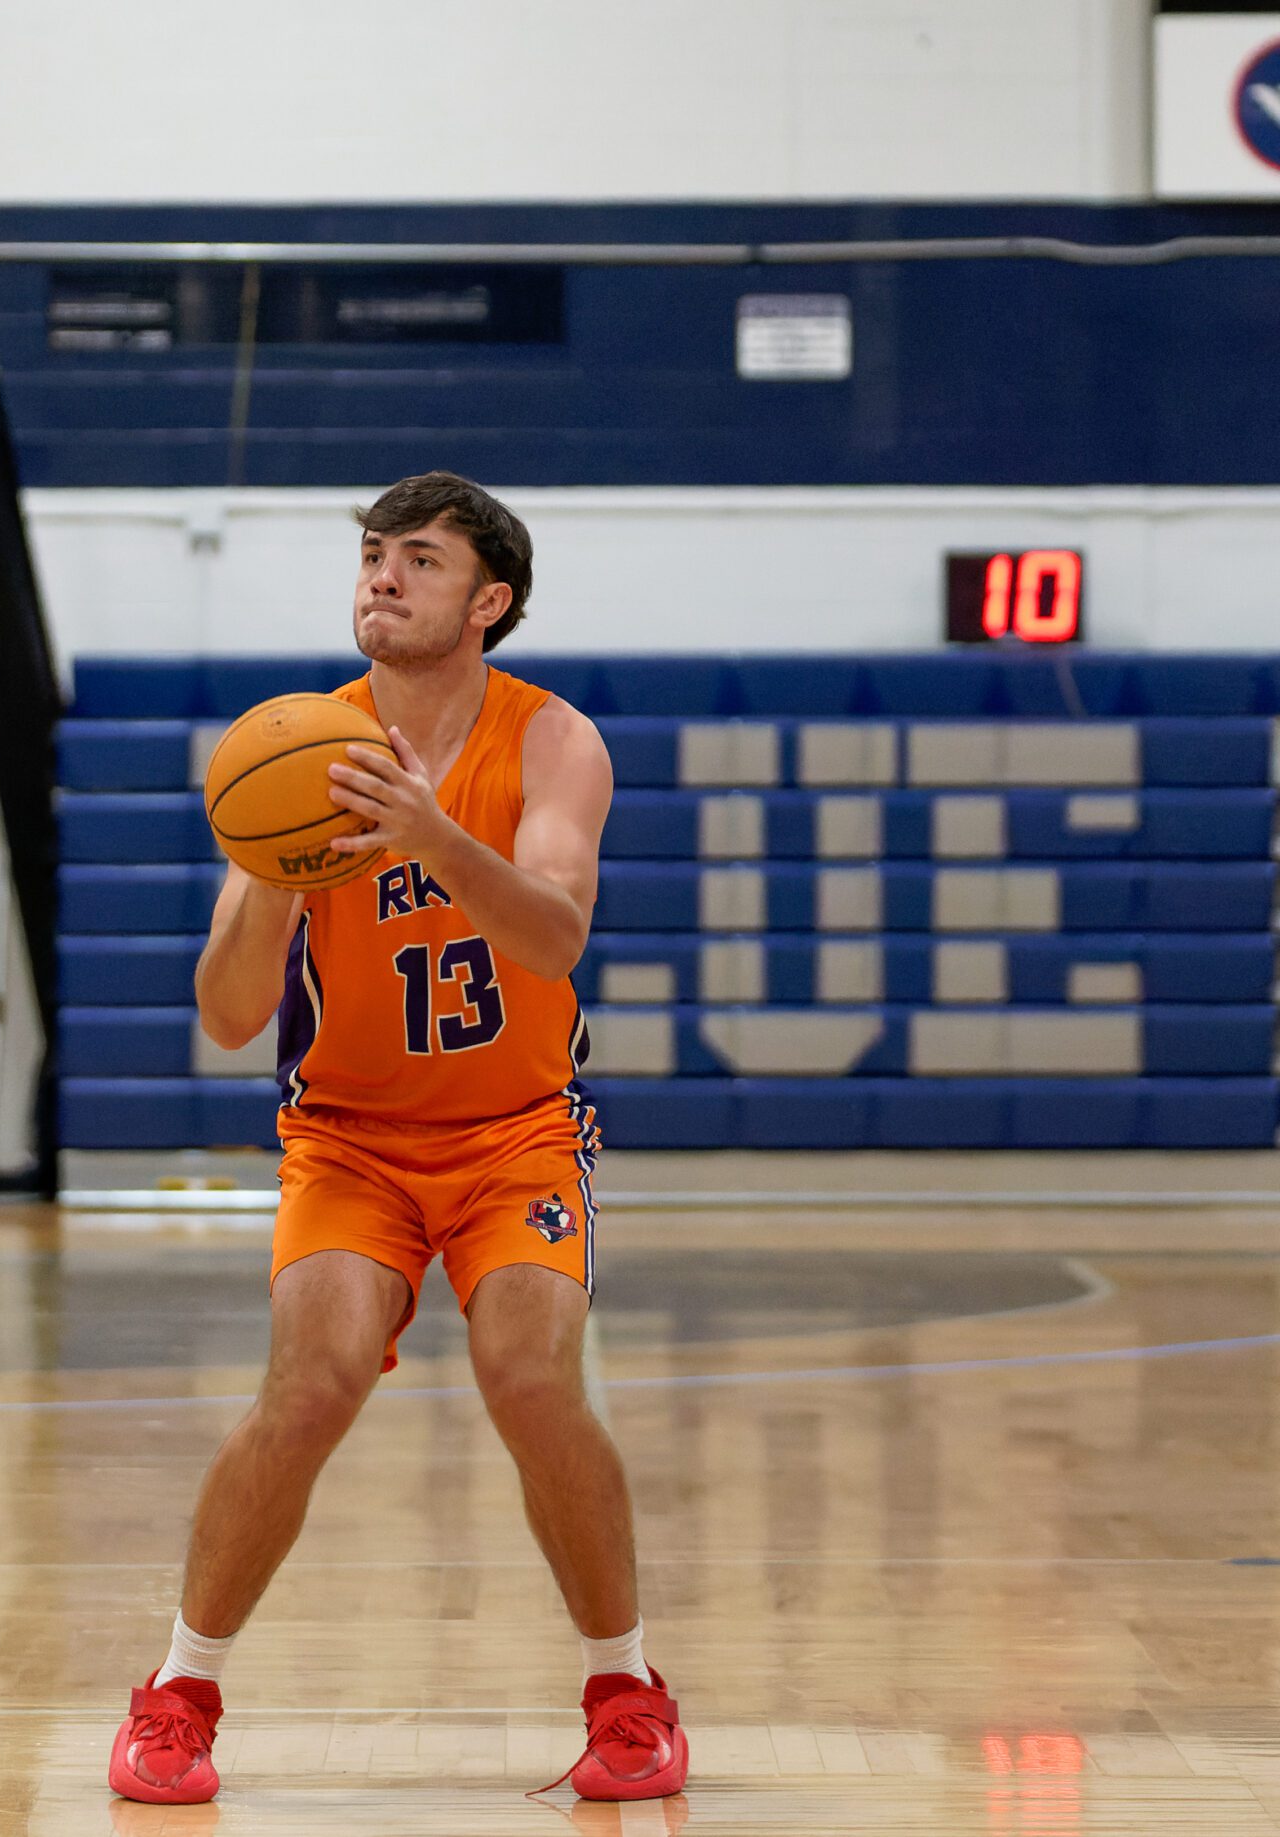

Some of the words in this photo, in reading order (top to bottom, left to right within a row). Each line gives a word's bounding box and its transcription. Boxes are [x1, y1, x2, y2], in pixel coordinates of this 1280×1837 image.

[982, 550, 1082, 642] 10
[372, 859, 454, 925] RK
[391, 934, 507, 1055] 13
